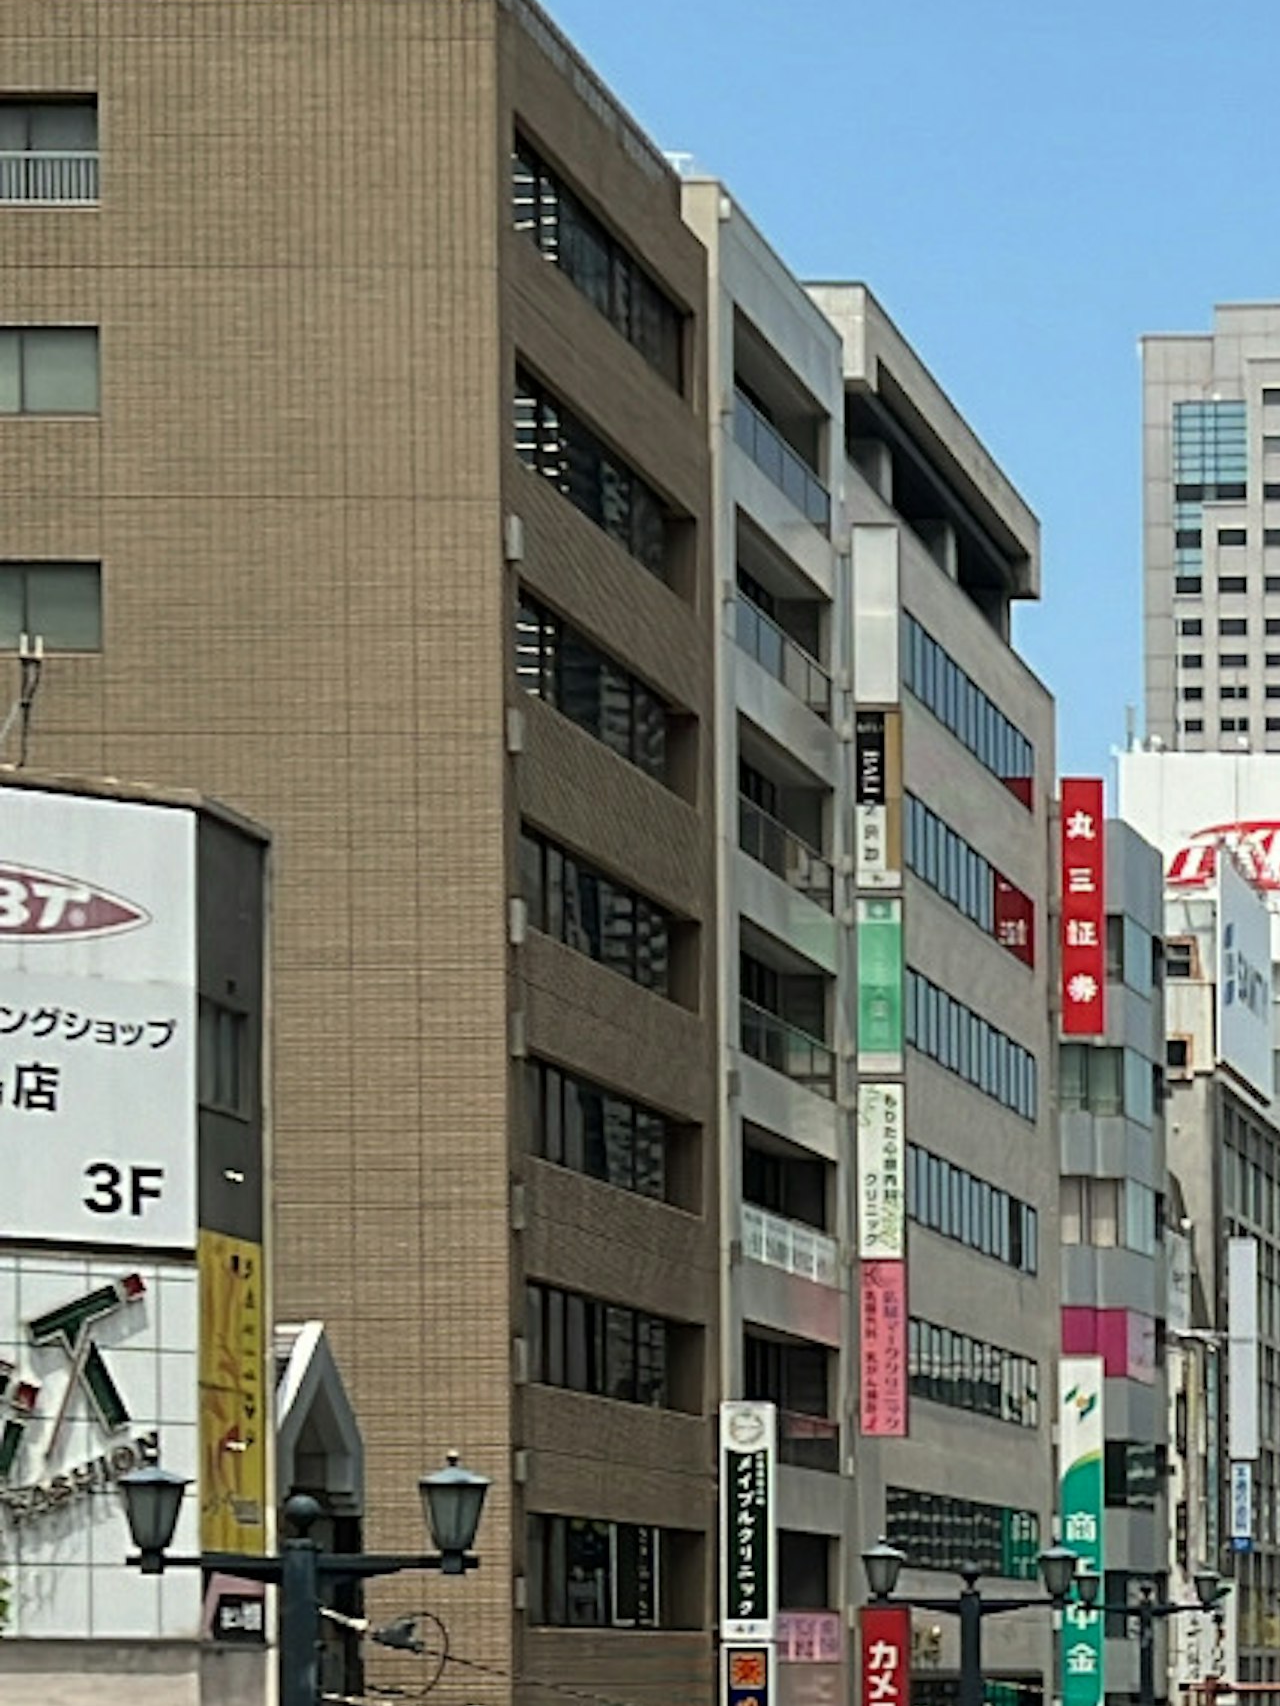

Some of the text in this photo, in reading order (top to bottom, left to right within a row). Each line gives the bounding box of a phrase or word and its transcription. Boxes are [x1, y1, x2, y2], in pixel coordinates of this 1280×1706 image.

[1067, 810, 1098, 1003] 丸三証券
[0, 1063, 60, 1112] 店
[83, 1162, 164, 1216] 3F
[865, 1173, 878, 1247] クリニック
